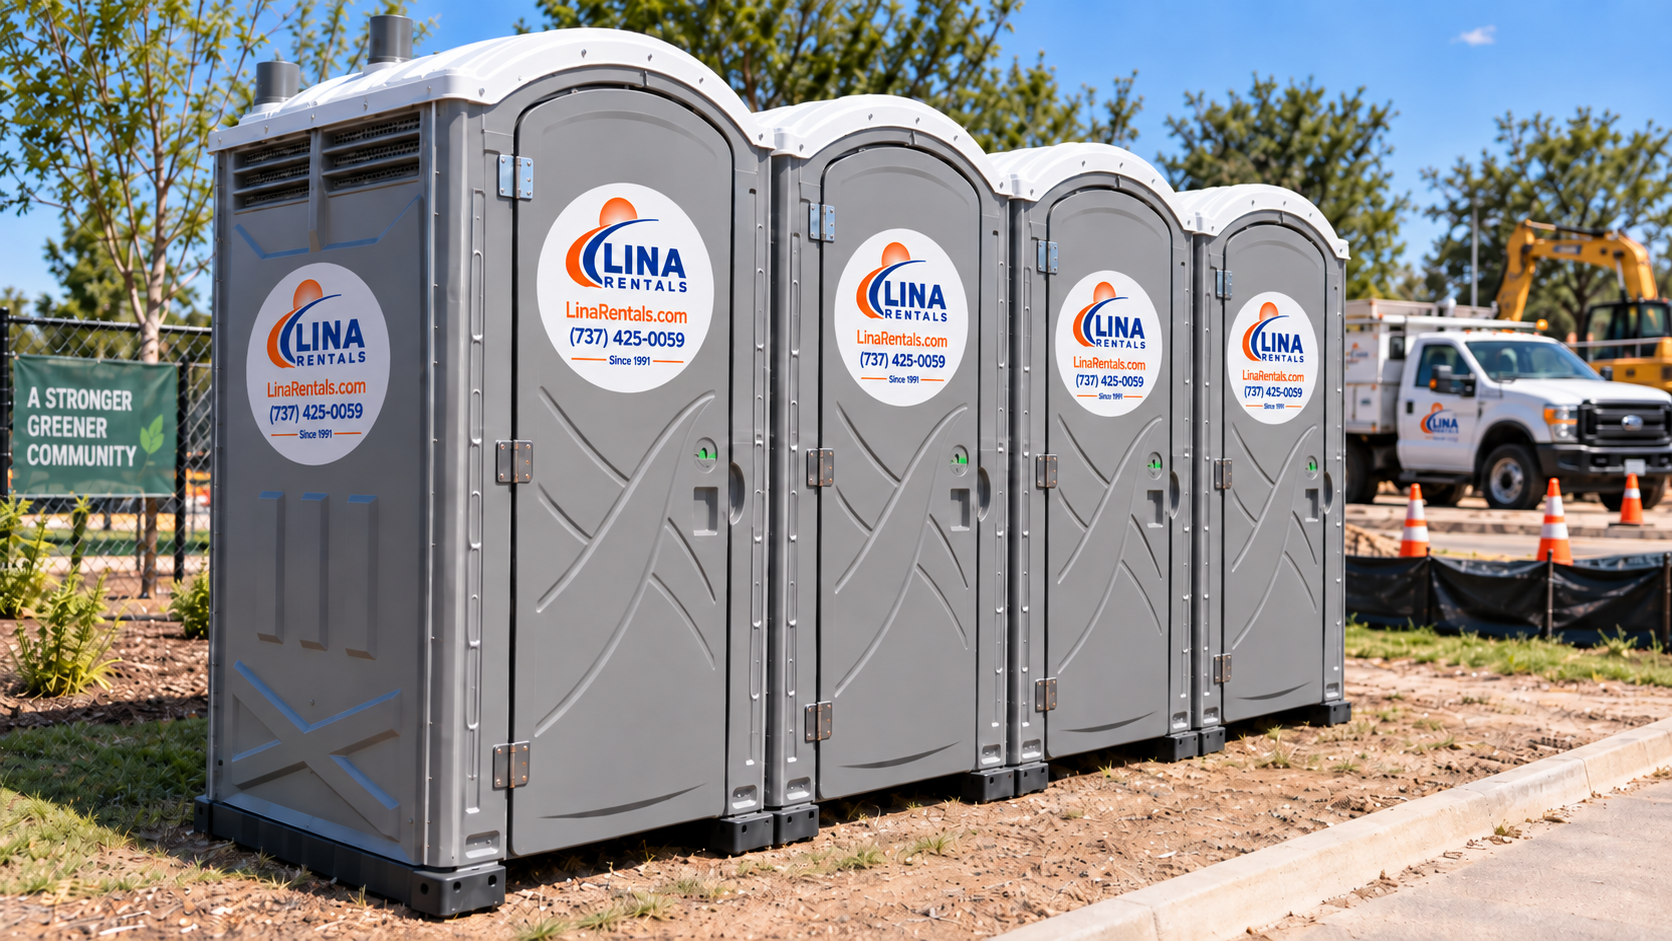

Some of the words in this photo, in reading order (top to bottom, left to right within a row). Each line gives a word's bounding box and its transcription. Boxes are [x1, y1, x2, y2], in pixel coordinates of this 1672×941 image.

[604, 243, 686, 279] LINA
[604, 276, 687, 293] RENTALS
[884, 280, 946, 309] LINA
[566, 301, 687, 324] LinaRentals.com
[885, 309, 947, 322] RENTALS
[296, 319, 365, 352] LINA
[1096, 315, 1145, 339] LINA
[570, 327, 608, 348] (737)
[613, 330, 685, 348] 425-0059
[857, 330, 947, 347] LinaRentals.com
[1096, 339, 1146, 349] RENTALS
[1261, 332, 1303, 354] LINA
[297, 351, 366, 367] RENTALS
[609, 355, 631, 365] Since
[634, 356, 650, 366] 1991
[860, 351, 888, 369] (737)
[892, 353, 945, 368] 425-0059
[1073, 356, 1146, 370] LinaRentals.com
[1262, 354, 1304, 363] RENTALS
[888, 375, 905, 383] Since
[907, 376, 919, 384] 1991
[1076, 374, 1098, 388] (737)
[1101, 375, 1144, 387] 425-0059
[1242, 370, 1304, 382] LinaRentals.com
[267, 379, 366, 398] LinaRentals.com
[1244, 386, 1264, 398] (737)
[1266, 387, 1302, 398] 425-0059
[27, 387, 40, 408] A
[45, 387, 132, 411] STRONGER
[270, 404, 299, 425] (737)
[302, 403, 363, 420] 425-0059
[27, 415, 107, 438] GREENER
[1433, 418, 1458, 428] LINA
[299, 430, 316, 439] Since
[318, 430, 332, 438] 1991
[27, 444, 137, 466] COMMUNITY
